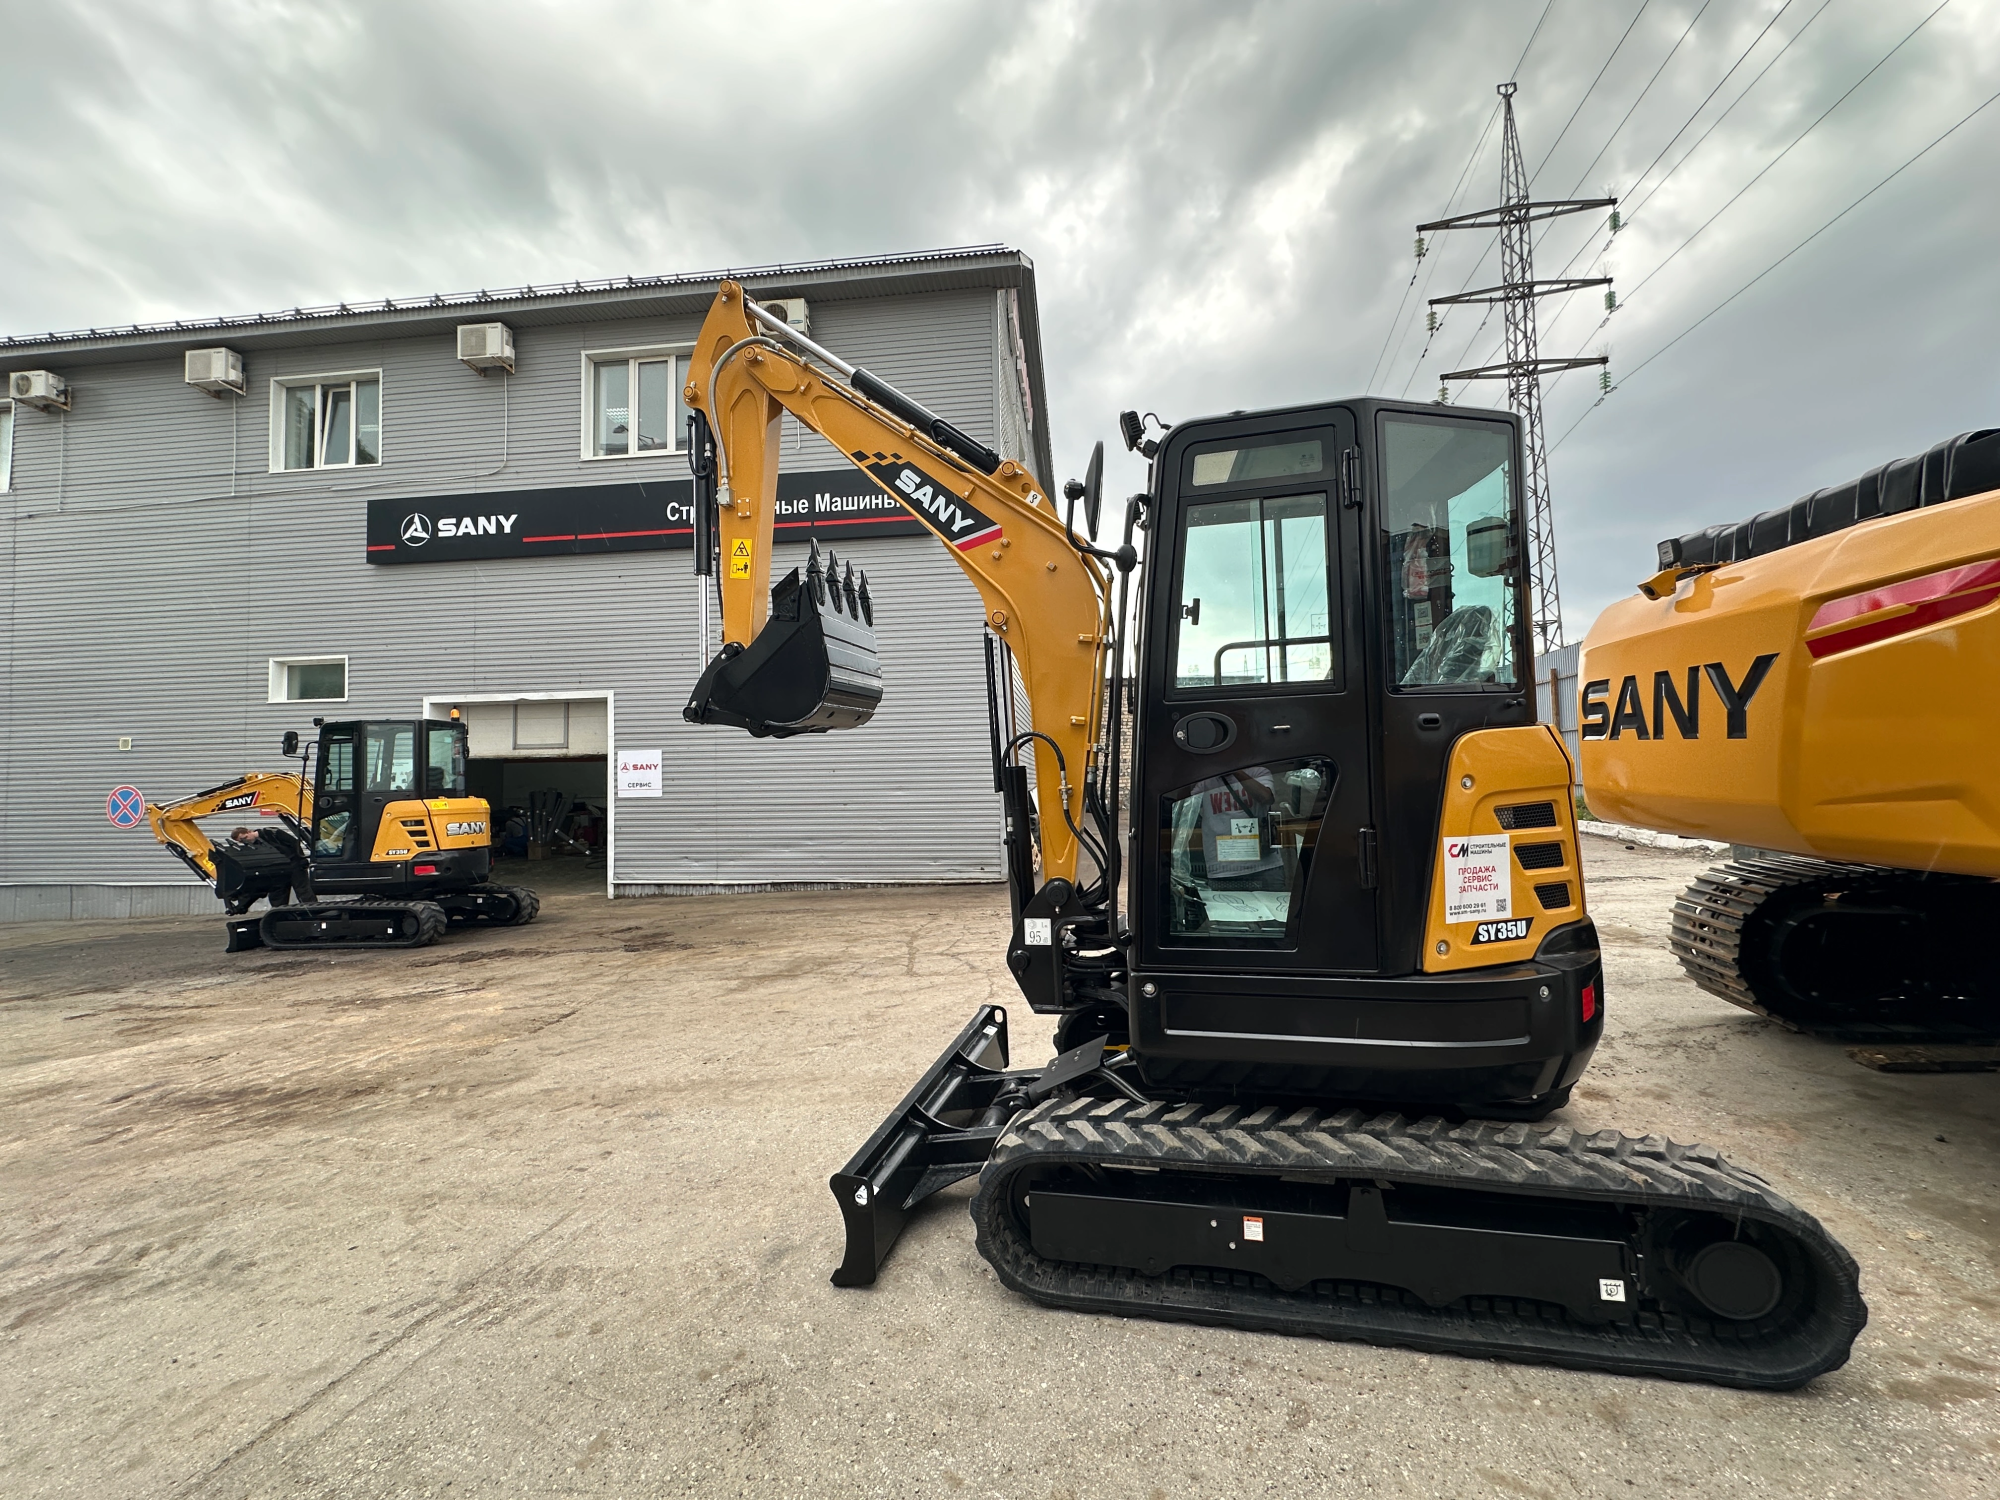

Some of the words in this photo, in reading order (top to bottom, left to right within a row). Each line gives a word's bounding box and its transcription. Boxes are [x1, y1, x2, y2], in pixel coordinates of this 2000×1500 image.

[894, 469, 975, 533] SANY
[437, 514, 518, 537] SANY
[1582, 652, 1780, 741] SANY
[632, 763, 659, 771] SANY
[225, 795, 252, 808] SANY
[446, 821, 486, 836] SANY
[1458, 866, 1497, 875] ПРОДАЖА
[1463, 875, 1493, 884] СЕРВИС
[1458, 883, 1499, 894] ЗАПЧАСТИ
[1029, 930, 1042, 944] 95
[1478, 920, 1527, 942] SY35U
